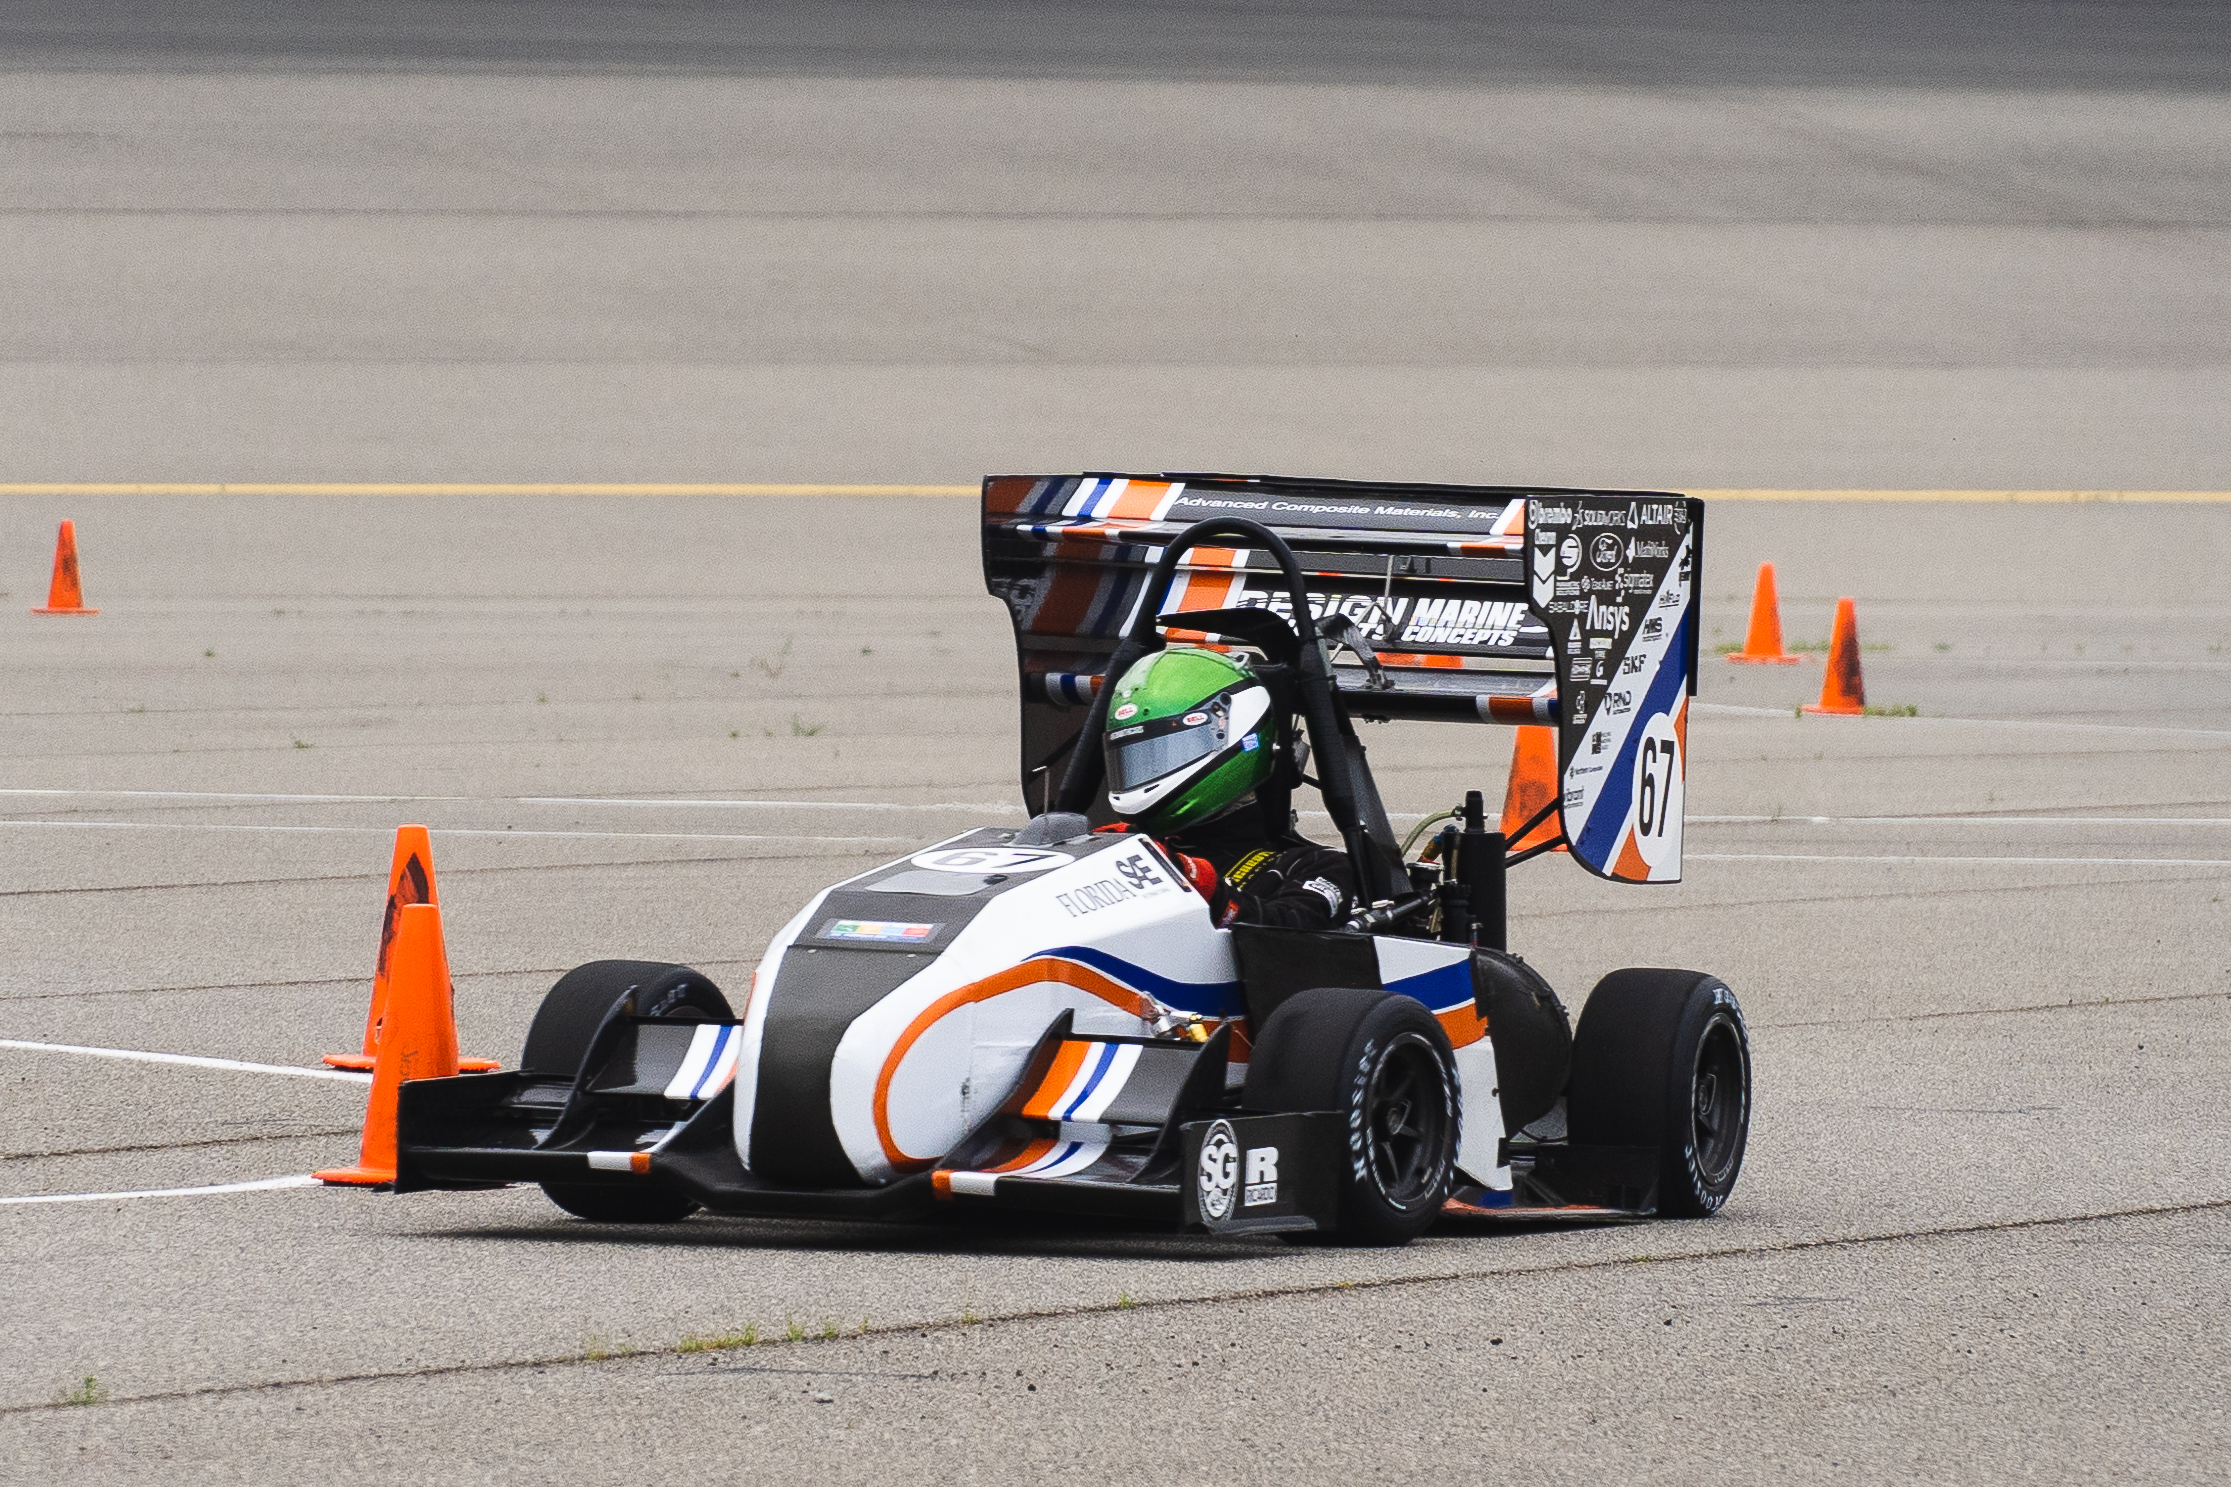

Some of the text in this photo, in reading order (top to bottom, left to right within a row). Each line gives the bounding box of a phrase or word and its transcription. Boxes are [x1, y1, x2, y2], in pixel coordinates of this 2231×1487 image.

[1174, 496, 1500, 519] Advanced Composite Materials, Inc.
[1640, 504, 1673, 525] ALTAIR
[1596, 537, 1617, 563] Ford
[1411, 598, 1529, 629] MARINE
[1585, 594, 1630, 639] Ansys
[1401, 625, 1519, 647] CONCEPTS
[1622, 653, 1647, 675] SKF
[1639, 736, 1675, 838] 67
[931, 850, 1059, 869] 67
[1055, 877, 1137, 918] FLORIDA
[1115, 853, 1164, 890] SAE
[1200, 1142, 1237, 1192] SG
[1246, 1146, 1279, 1184] R
